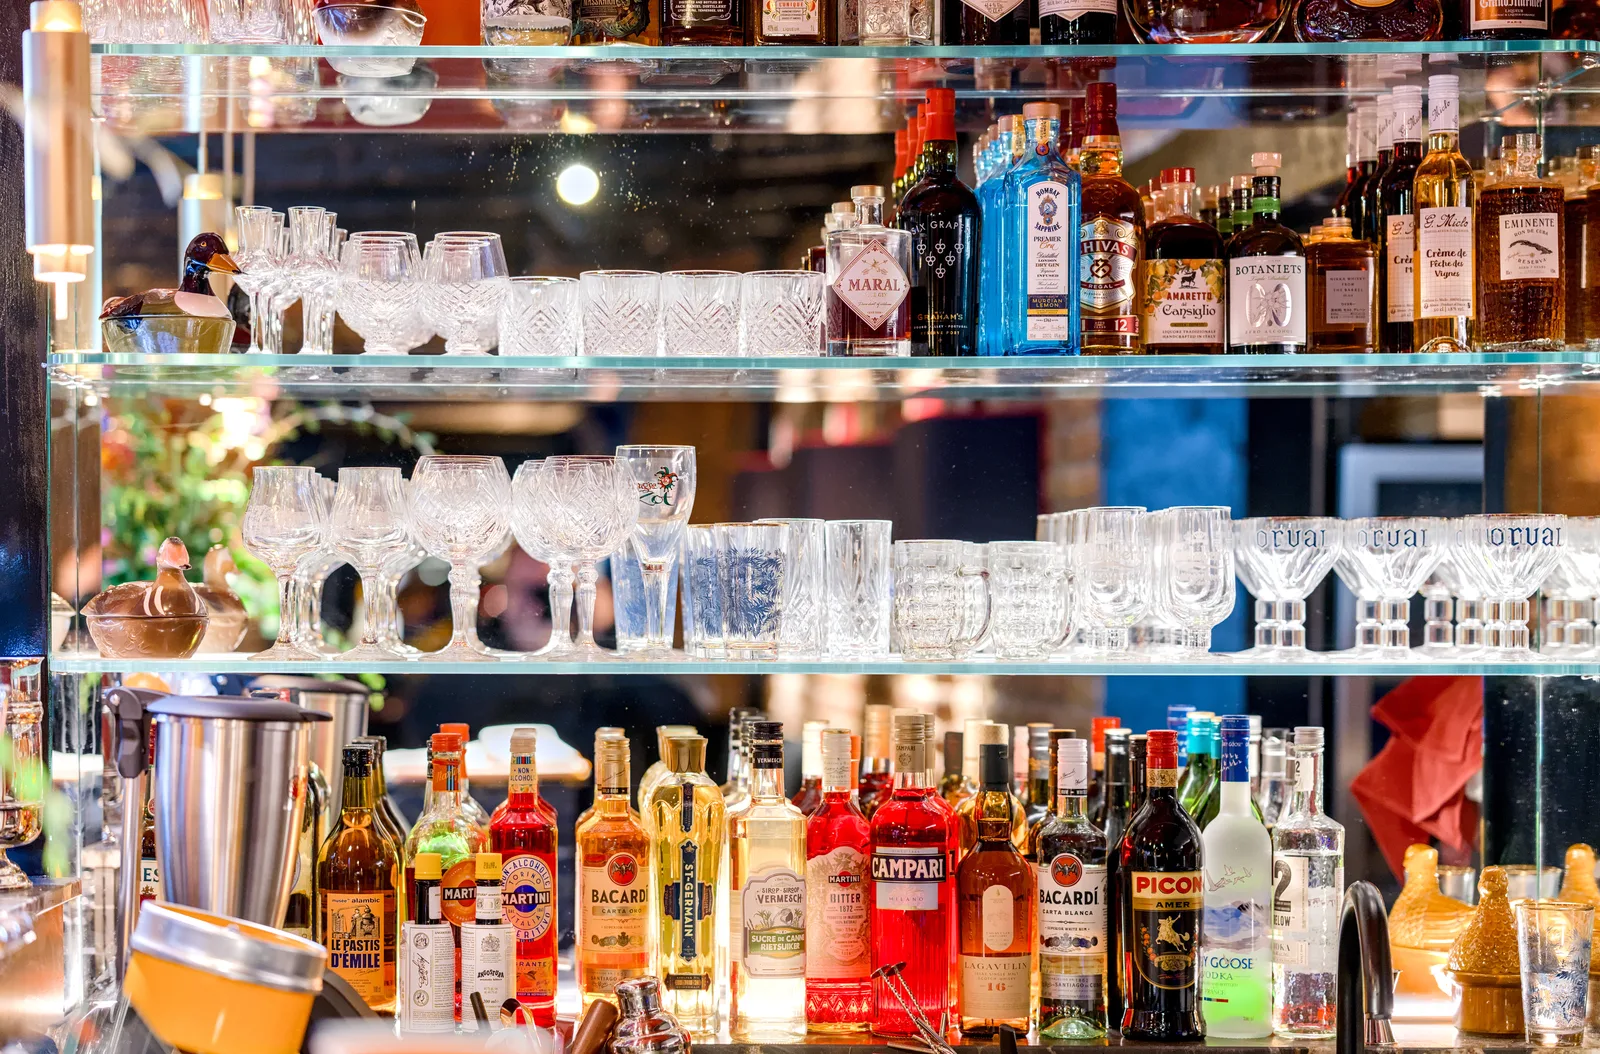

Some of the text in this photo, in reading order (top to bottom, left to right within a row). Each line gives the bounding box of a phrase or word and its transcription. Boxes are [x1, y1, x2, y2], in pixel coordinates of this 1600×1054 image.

[1430, 99, 1451, 122] Miclo
[1036, 187, 1061, 199] BOMBAY
[1034, 222, 1062, 232] SAPPHIRE
[1424, 213, 1437, 229] G.
[1437, 213, 1469, 228] Miclo
[1504, 218, 1556, 230] EMINENTE
[911, 220, 965, 236] SIX GRAPE
[1535, 228, 1549, 236] CUBA
[1083, 241, 1130, 255] HIVAS
[1426, 248, 1468, 259] Crème de
[1393, 255, 1414, 264] Crè
[1429, 259, 1465, 268] Pêche des
[1235, 264, 1303, 276] BOTANIETS
[1434, 269, 1461, 280] Vignes
[848, 278, 901, 291] MARAL
[1166, 292, 1213, 301] AMARETTO
[917, 313, 964, 321] GRAHAM'S
[1162, 304, 1216, 320] Cansiglio
[1114, 318, 1128, 331] 12
[639, 489, 676, 507] Zot
[1295, 760, 1300, 773] 2
[871, 856, 944, 879] CAMPARI
[143, 867, 159, 882] ES
[508, 872, 542, 886] TORINO
[829, 875, 860, 883] MARTINI
[1135, 876, 1203, 894] PICON
[1274, 859, 1292, 913] 2
[351, 896, 381, 904] alambic
[444, 888, 477, 900] MARTI
[501, 890, 550, 905] MARTINI
[591, 884, 649, 904] BACARDÍ
[757, 893, 802, 904] VERMESCH
[830, 893, 861, 904] BITTER
[1039, 886, 1099, 906] BACARDÍ
[682, 863, 694, 938] ST-GERMAIN
[510, 911, 542, 927] ITALIA
[1273, 914, 1291, 927] ELOW
[751, 935, 777, 943] SUCRE
[786, 934, 805, 943] CANN
[331, 939, 381, 952] LE PASTIS
[760, 943, 801, 951] RIETSUIKER
[331, 950, 381, 969] D'ÉMILE
[1209, 956, 1254, 970] GOOSE
[964, 961, 1028, 972] LAGAVULIN
[476, 969, 505, 979] ANGOSTURA
[1204, 970, 1234, 981] ODKA
[987, 982, 1007, 992] 16
[1054, 981, 1085, 989] SANTIAGO
